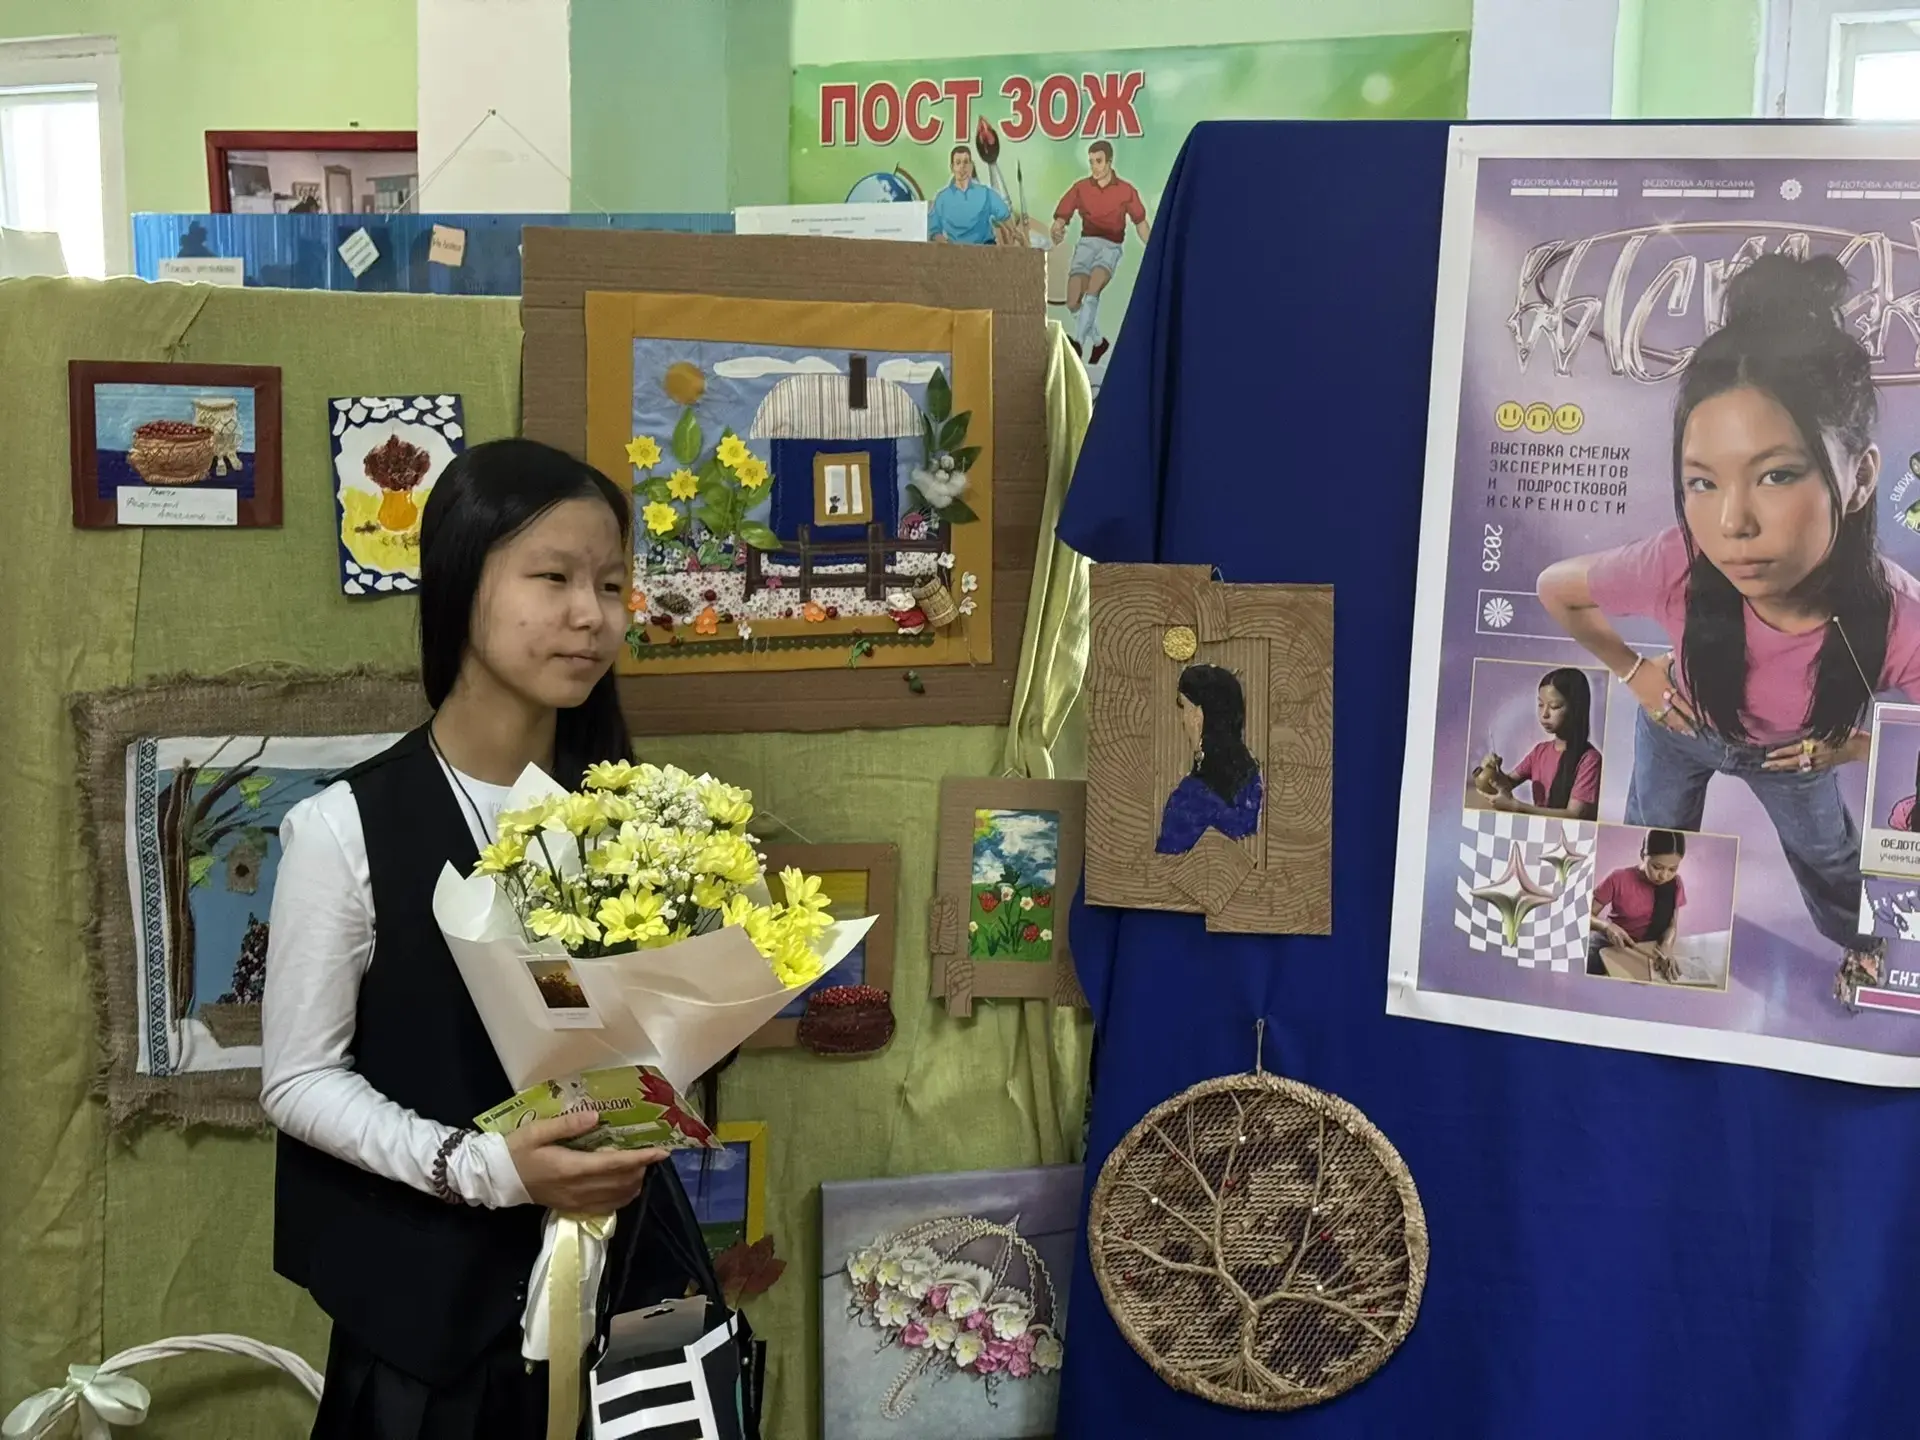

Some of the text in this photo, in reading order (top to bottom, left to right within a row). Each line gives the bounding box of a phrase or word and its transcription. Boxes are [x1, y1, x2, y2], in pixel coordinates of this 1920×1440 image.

[820, 70, 1145, 146] ПОСТ ЗОЖ
[1510, 178, 1560, 187] ФЕДОТОВА
[1642, 178, 1693, 188] ФЕДОТОВА
[1490, 441, 1631, 461] ВЫСТАВКА СМЕЛЫХ
[1489, 459, 1629, 479] ЭКСПЕРИМЕНТОВ
[1487, 478, 1628, 497] И ПОДРОСТКОВОЙ
[1486, 495, 1626, 515] ИСКРЕННОСТИ
[1481, 523, 1504, 573] 2026
